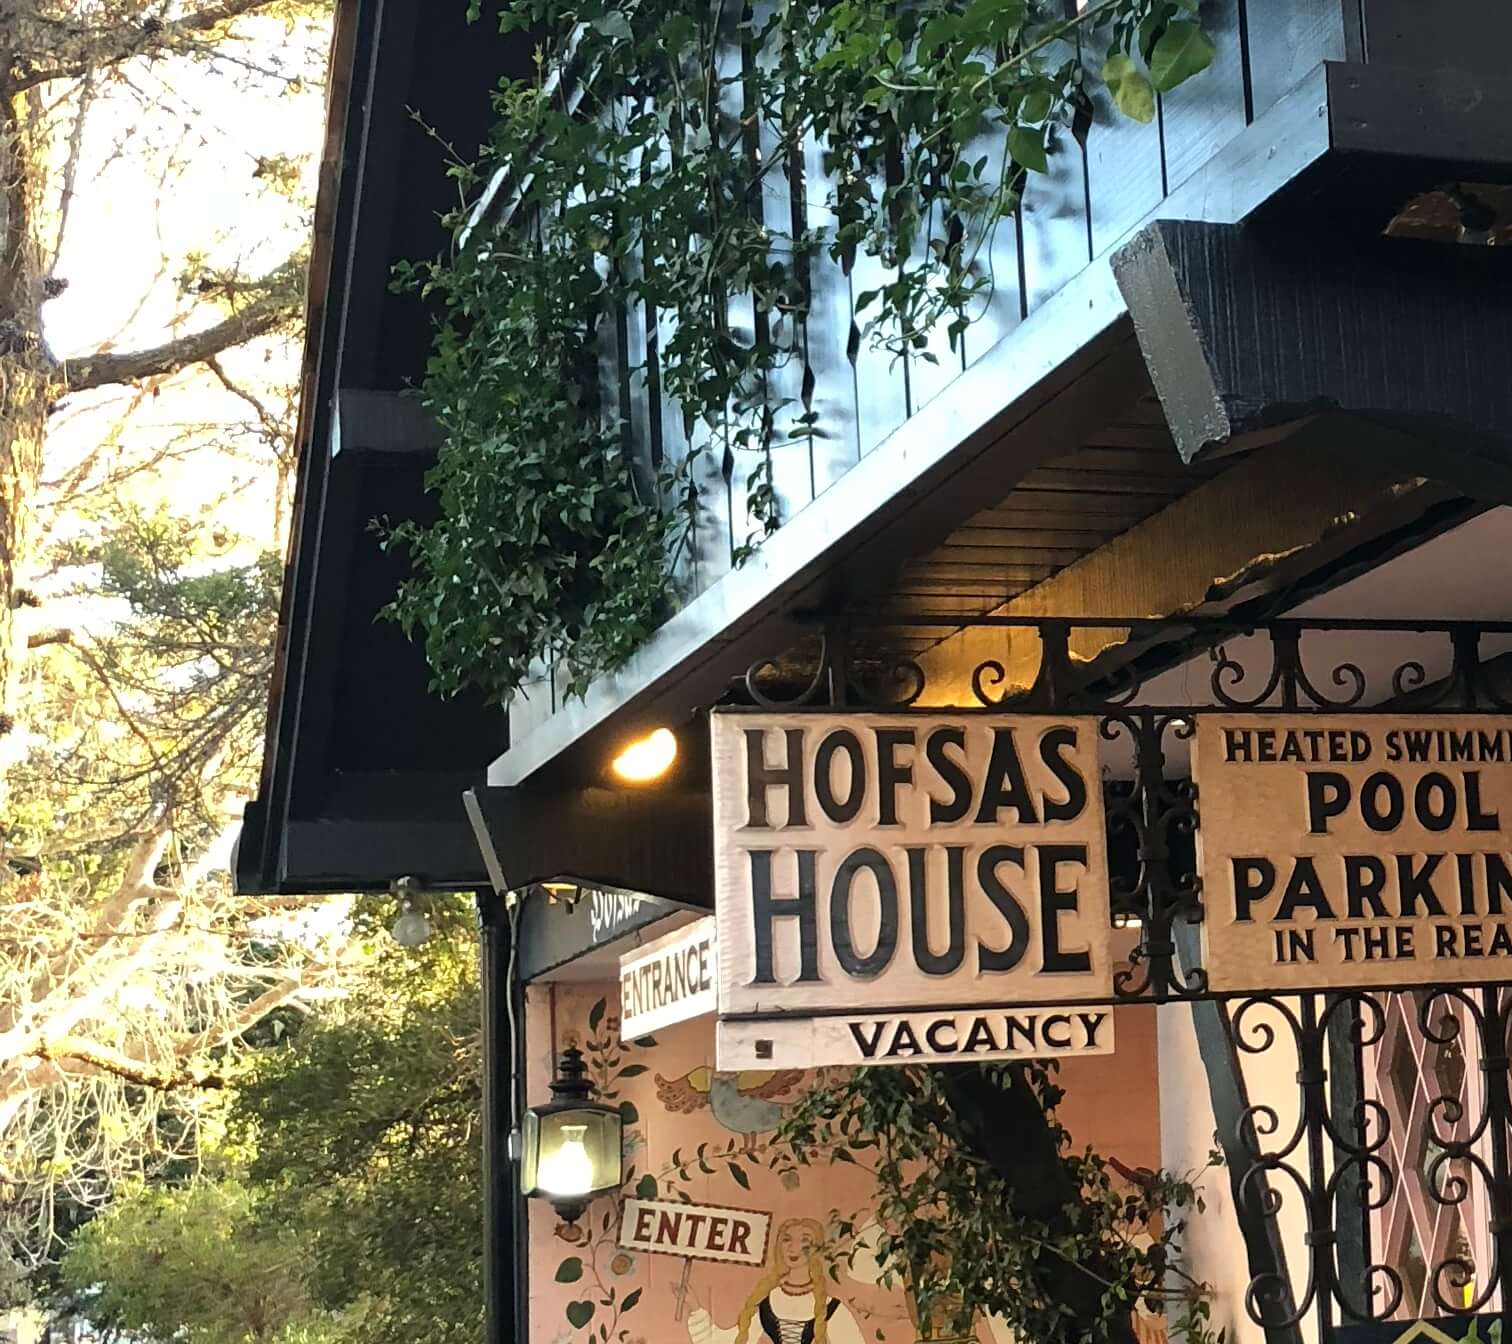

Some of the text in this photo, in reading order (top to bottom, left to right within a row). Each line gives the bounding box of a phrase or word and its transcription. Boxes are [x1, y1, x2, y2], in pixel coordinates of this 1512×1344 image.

[1223, 729, 1372, 762] HEATED
[743, 727, 1087, 826] HOFSAS
[1305, 770, 1499, 834] POOL
[747, 844, 1093, 983] HOUSE
[1274, 928, 1315, 963] IN
[1335, 925, 1415, 961] THE
[623, 939, 711, 1019] ENTRANCE
[848, 1013, 1109, 1058] VACANCY
[633, 1209, 752, 1254] ENTER
